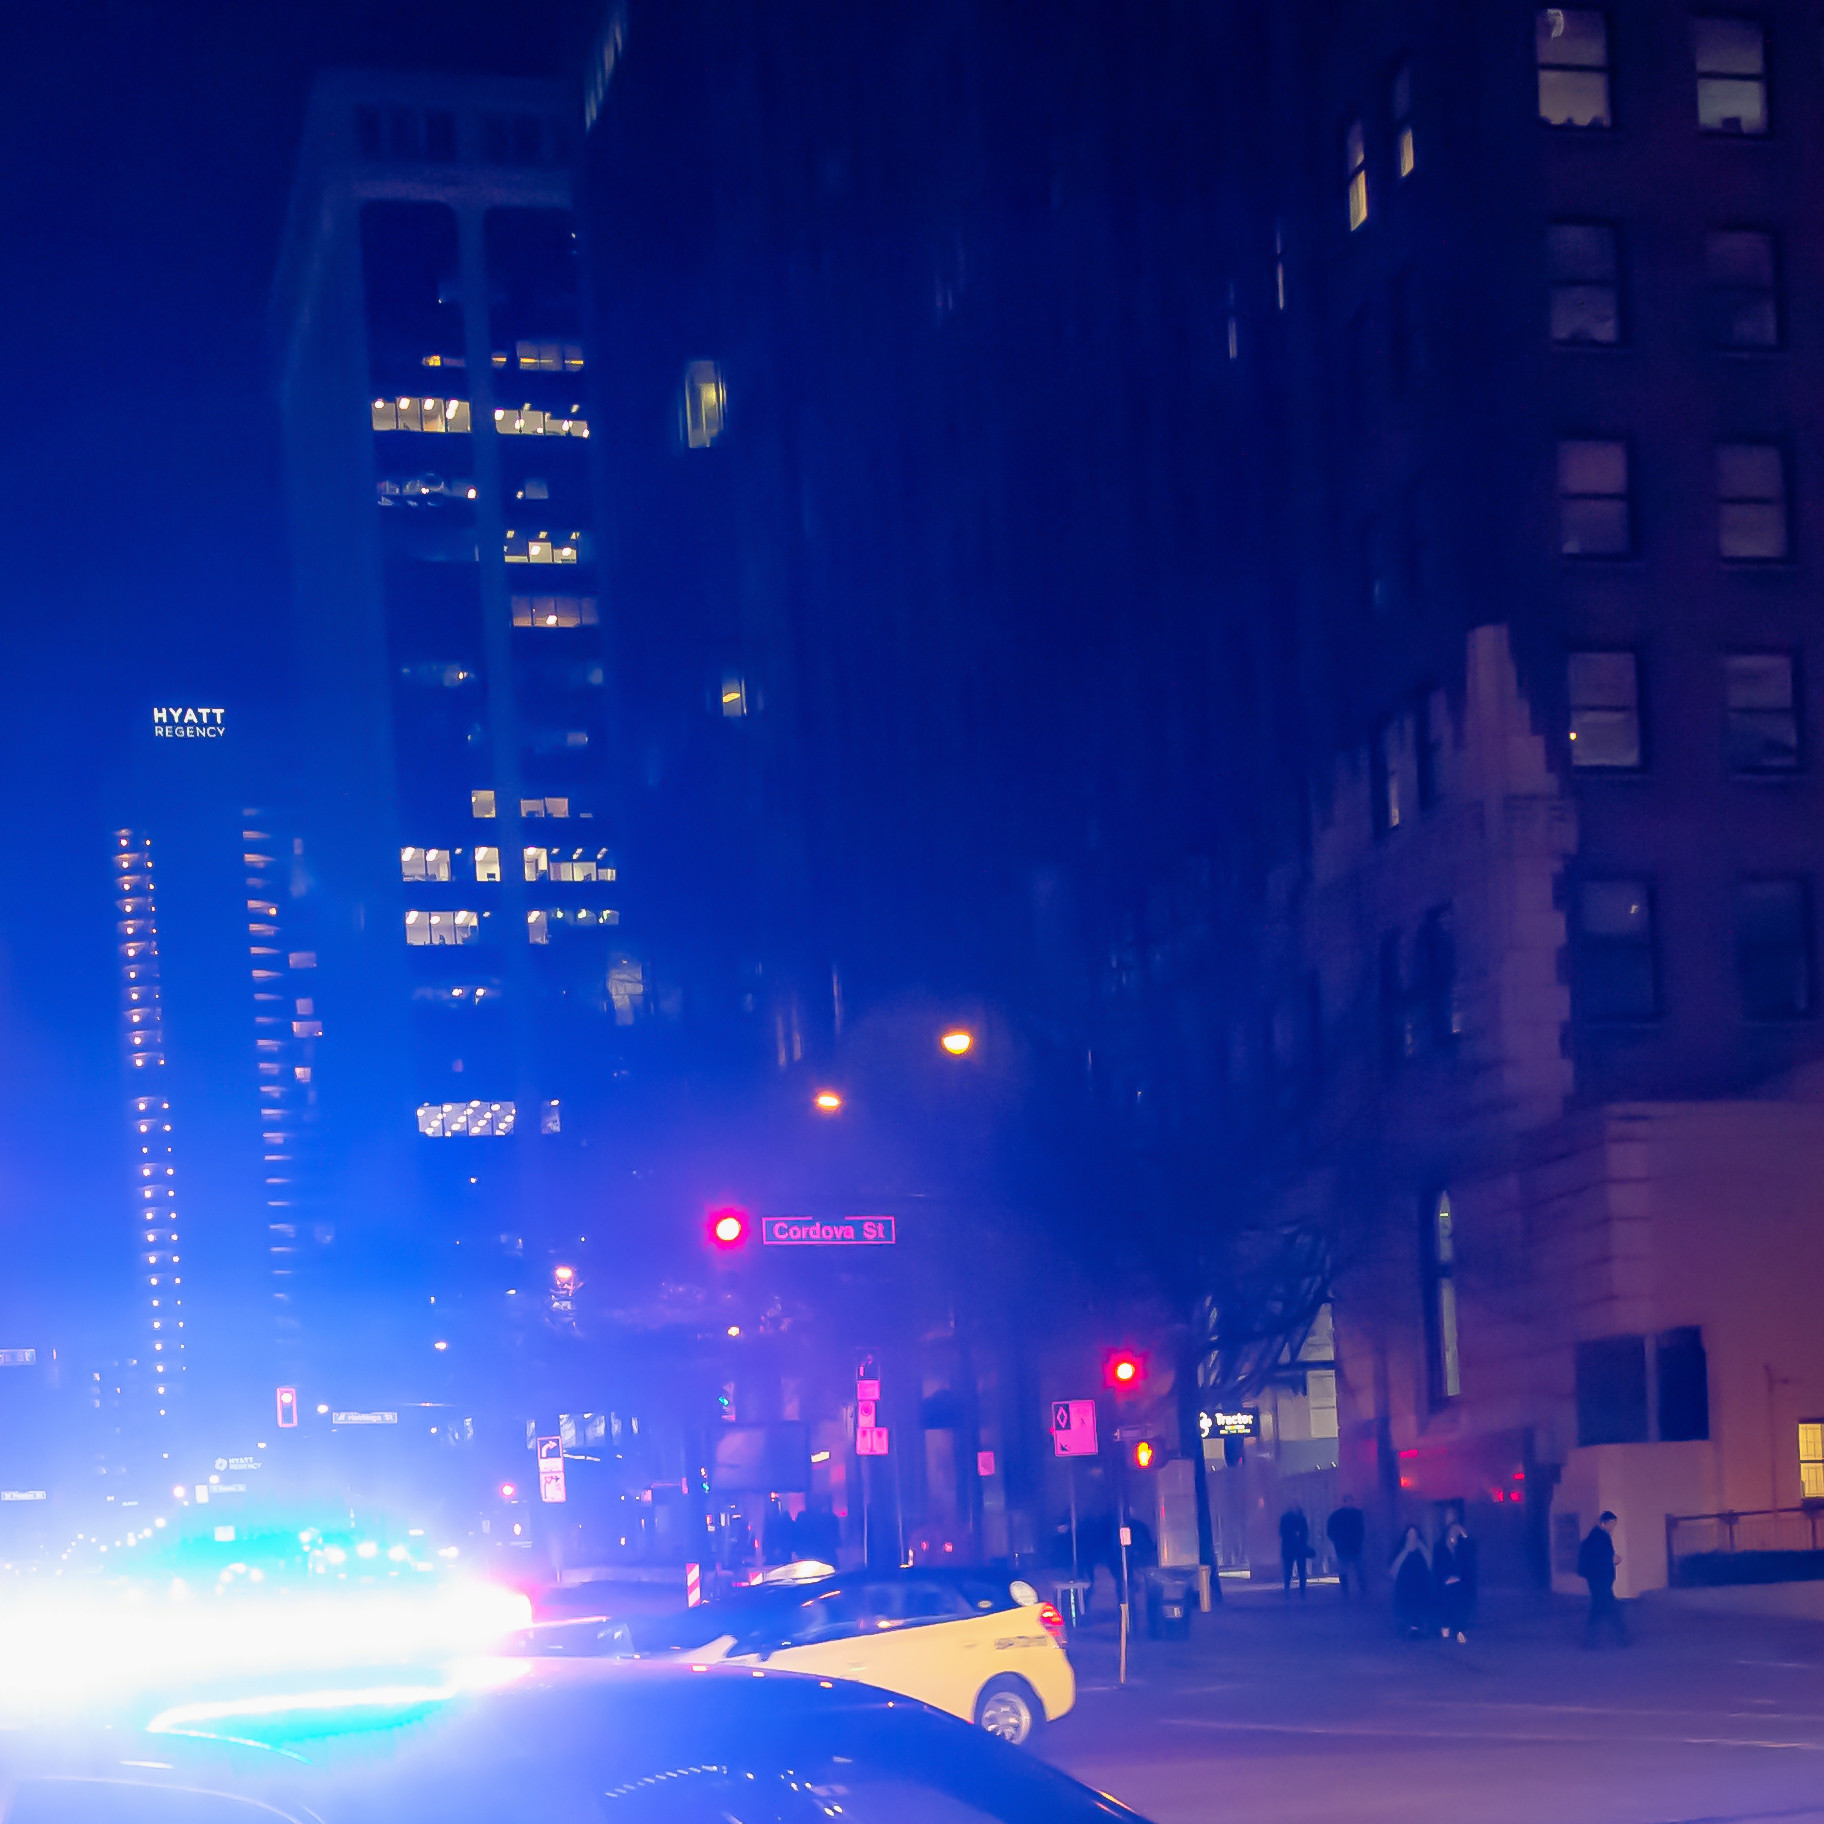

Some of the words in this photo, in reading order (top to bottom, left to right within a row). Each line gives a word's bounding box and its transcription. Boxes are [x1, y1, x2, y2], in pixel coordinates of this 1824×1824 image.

[153, 707, 225, 724] HYATT
[155, 725, 226, 738] REGENCY
[772, 1221, 855, 1240] Cordova
[862, 1221, 885, 1240] St
[1215, 1412, 1253, 1425] Tractor
